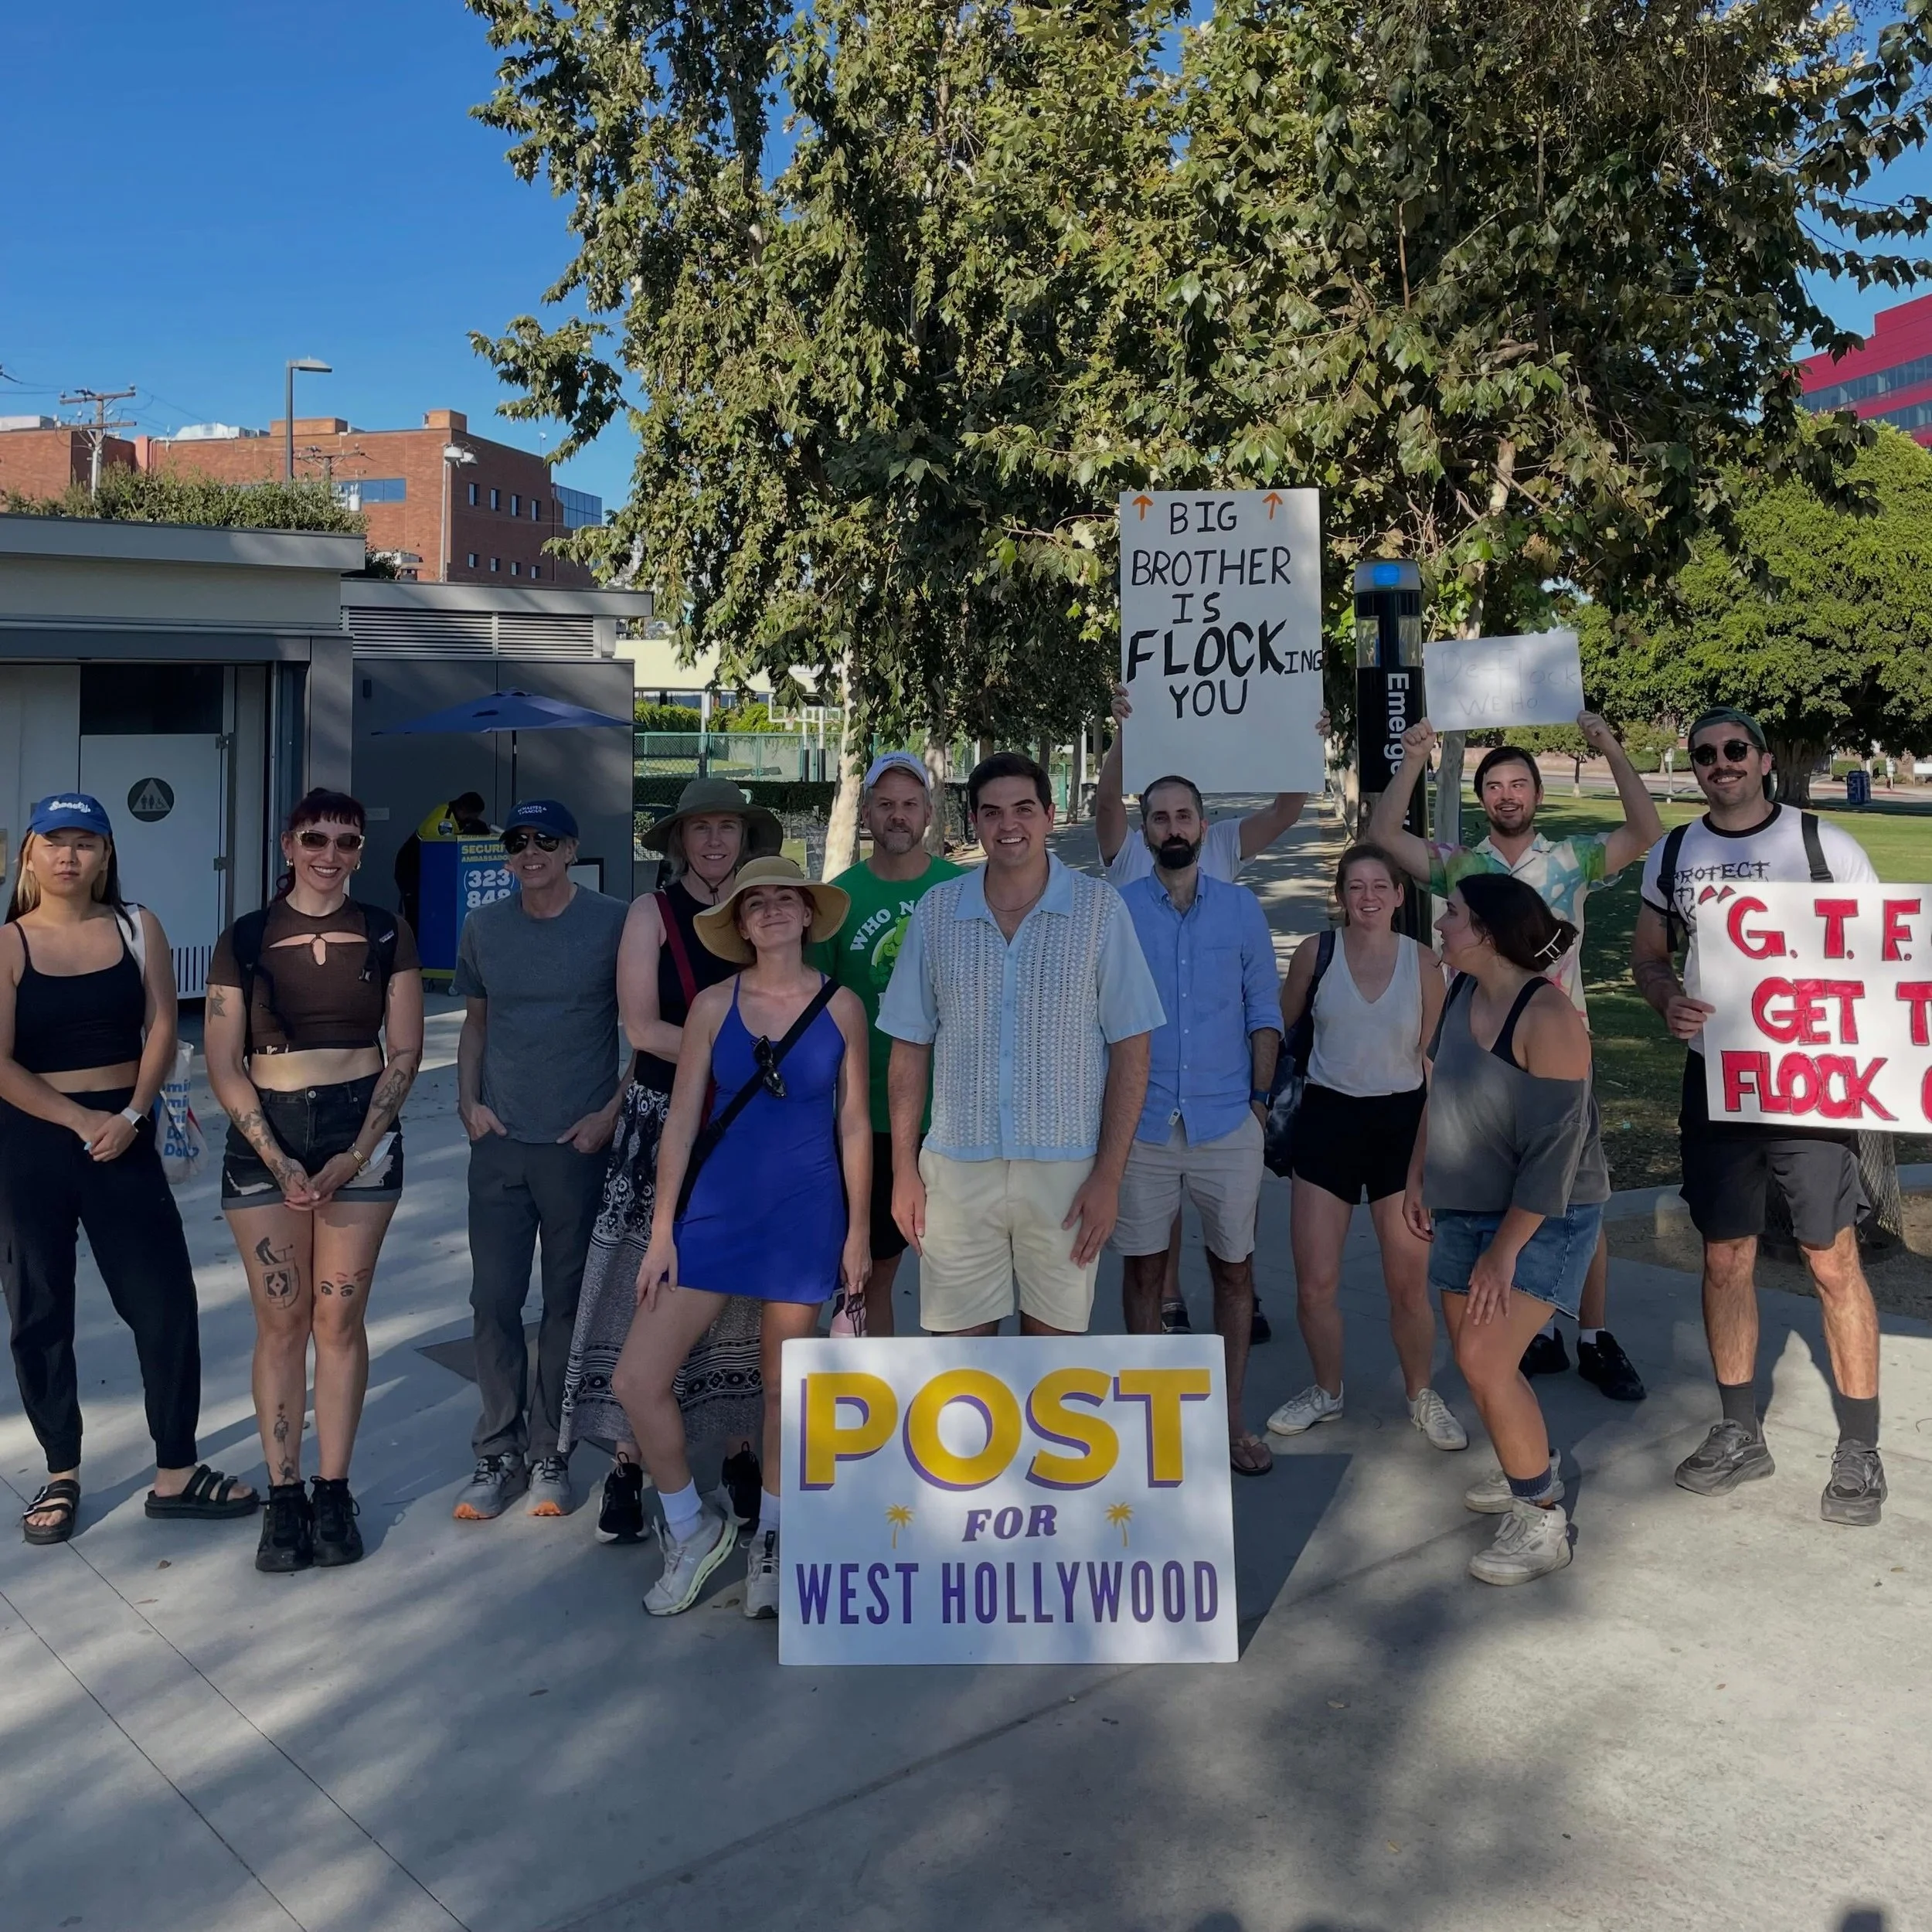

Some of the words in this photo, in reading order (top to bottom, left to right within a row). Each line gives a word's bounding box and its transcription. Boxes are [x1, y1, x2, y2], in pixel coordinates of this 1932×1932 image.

[1169, 501, 1238, 536] BIG
[1131, 546, 1292, 587] BROTHER
[1171, 591, 1221, 624] IS
[1168, 679, 1249, 719] YOU
[461, 843, 506, 855] SECURI
[461, 854, 512, 863] AMBASSADO
[464, 868, 515, 892] (323)
[849, 908, 892, 951] WHO
[898, 900, 916, 916] N
[1751, 976, 1866, 1046] GET
[1896, 981, 1932, 1046] T
[1720, 1049, 1900, 1121] FLOCK
[799, 1367, 1212, 1492] POST
[961, 1503, 1059, 1543] FOR
[795, 1562, 920, 1625] WEST
[941, 1560, 1219, 1624] HOLLYWOOD
